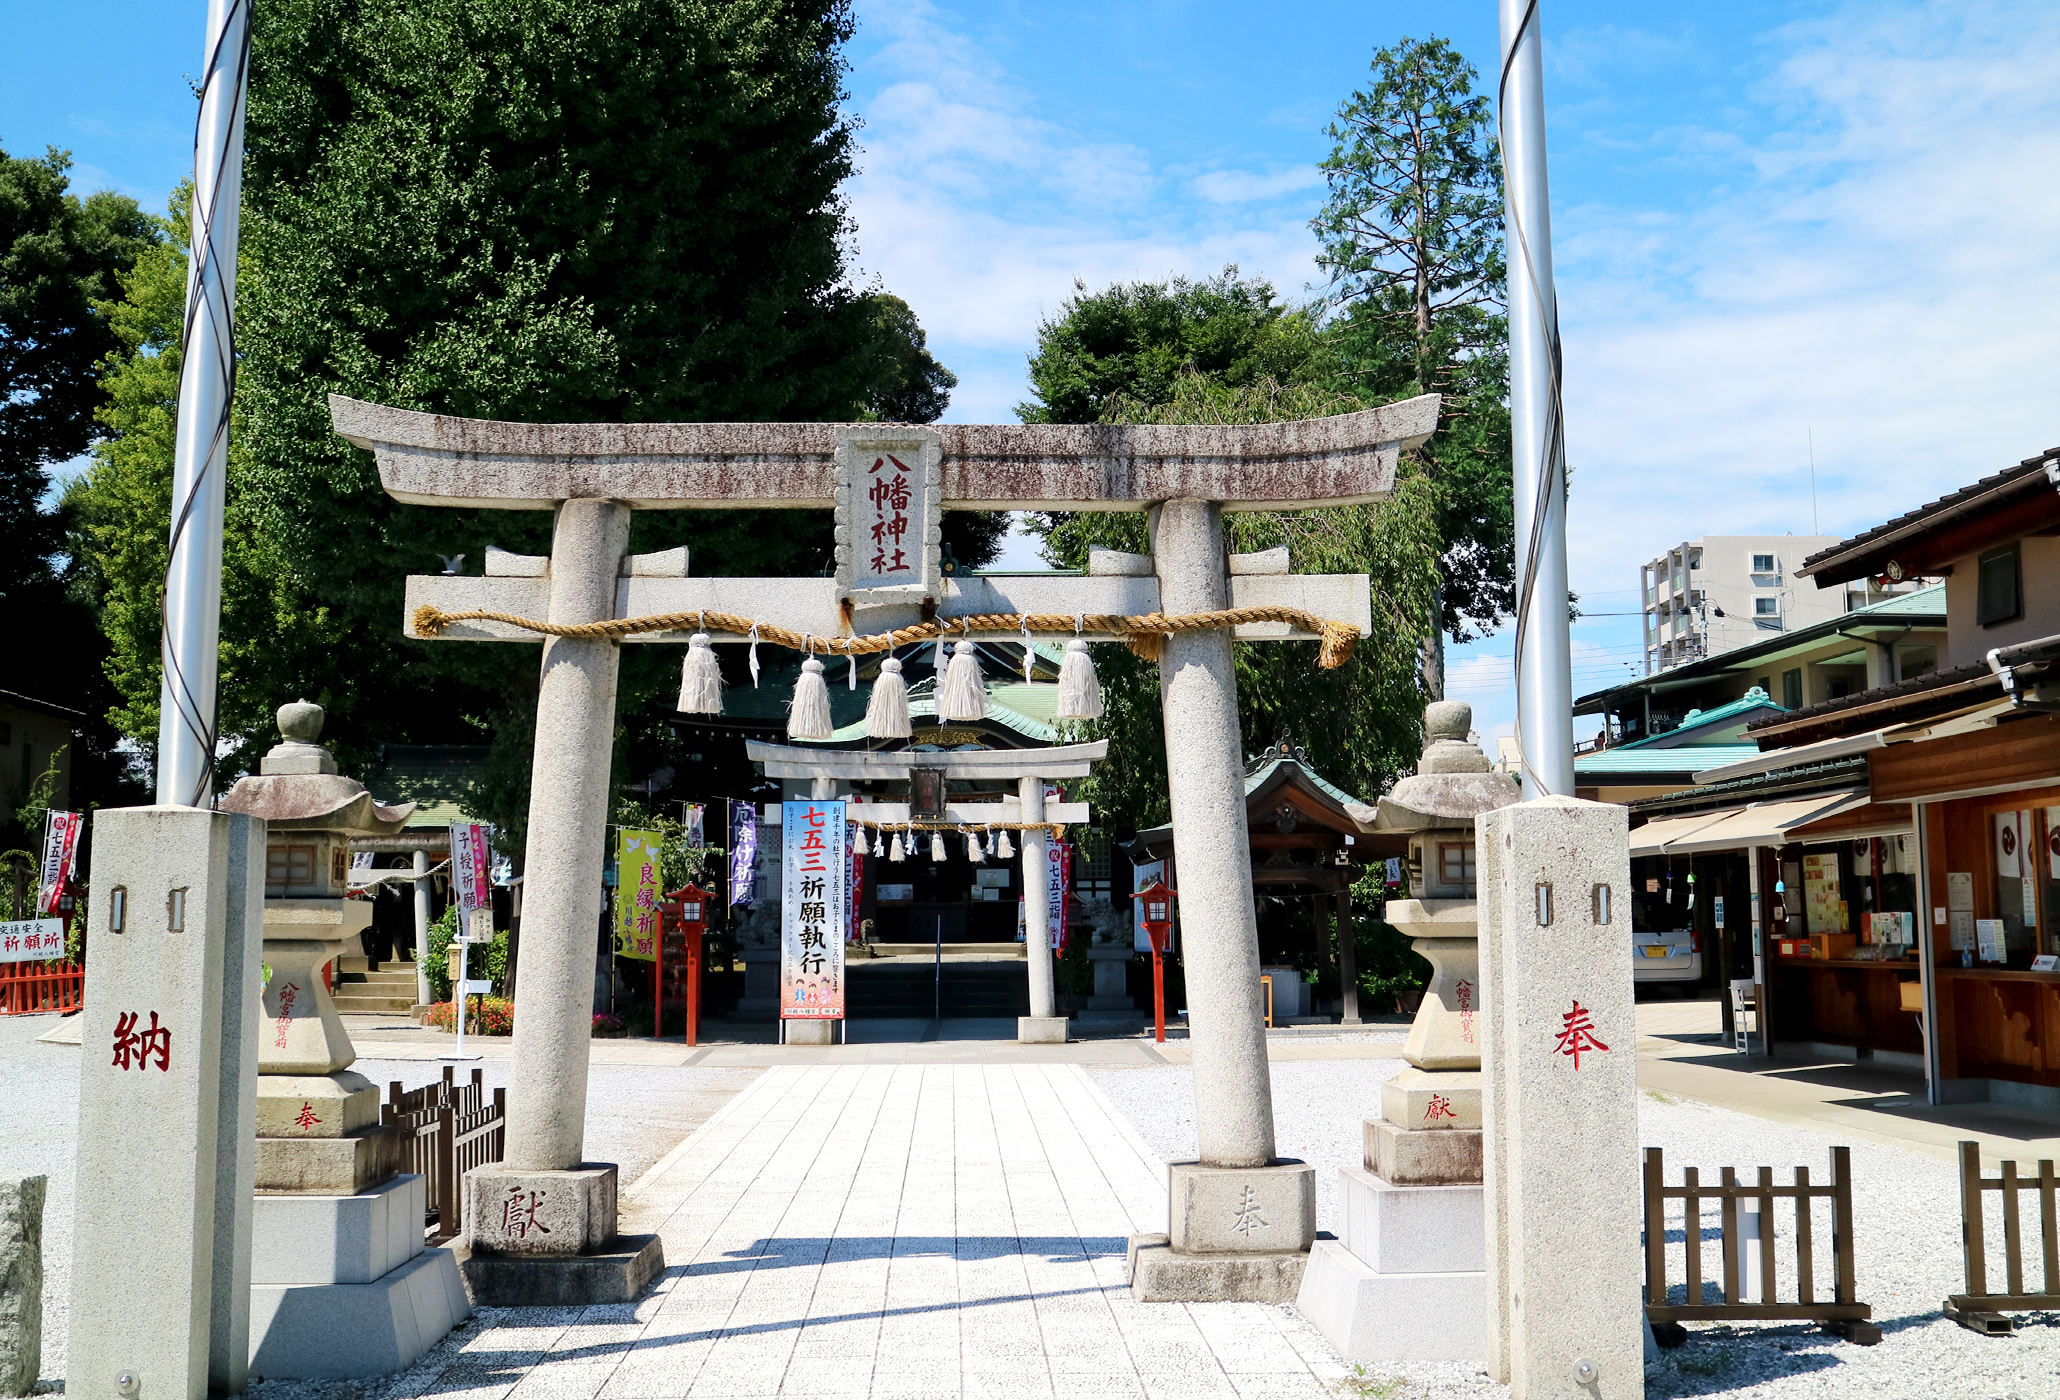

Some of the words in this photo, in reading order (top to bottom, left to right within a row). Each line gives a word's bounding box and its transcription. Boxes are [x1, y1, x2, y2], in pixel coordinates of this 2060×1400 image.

[868, 454, 912, 575] 八幡神社
[48, 832, 63, 885] 七五三詣
[458, 832, 477, 909] 子授祈願
[734, 806, 755, 901] 厄除け祈願
[636, 862, 658, 956] 良縁祈願
[799, 806, 827, 975] 七五三祈願執行
[1050, 865, 1061, 919] 七五三詣
[0, 922, 43, 935] 交通安全
[3, 932, 61, 952] 祈願所
[111, 1010, 172, 1072] 納
[1552, 999, 1610, 1072] 奉
[294, 1101, 323, 1131] 奉
[1231, 1185, 1271, 1238] 奉
